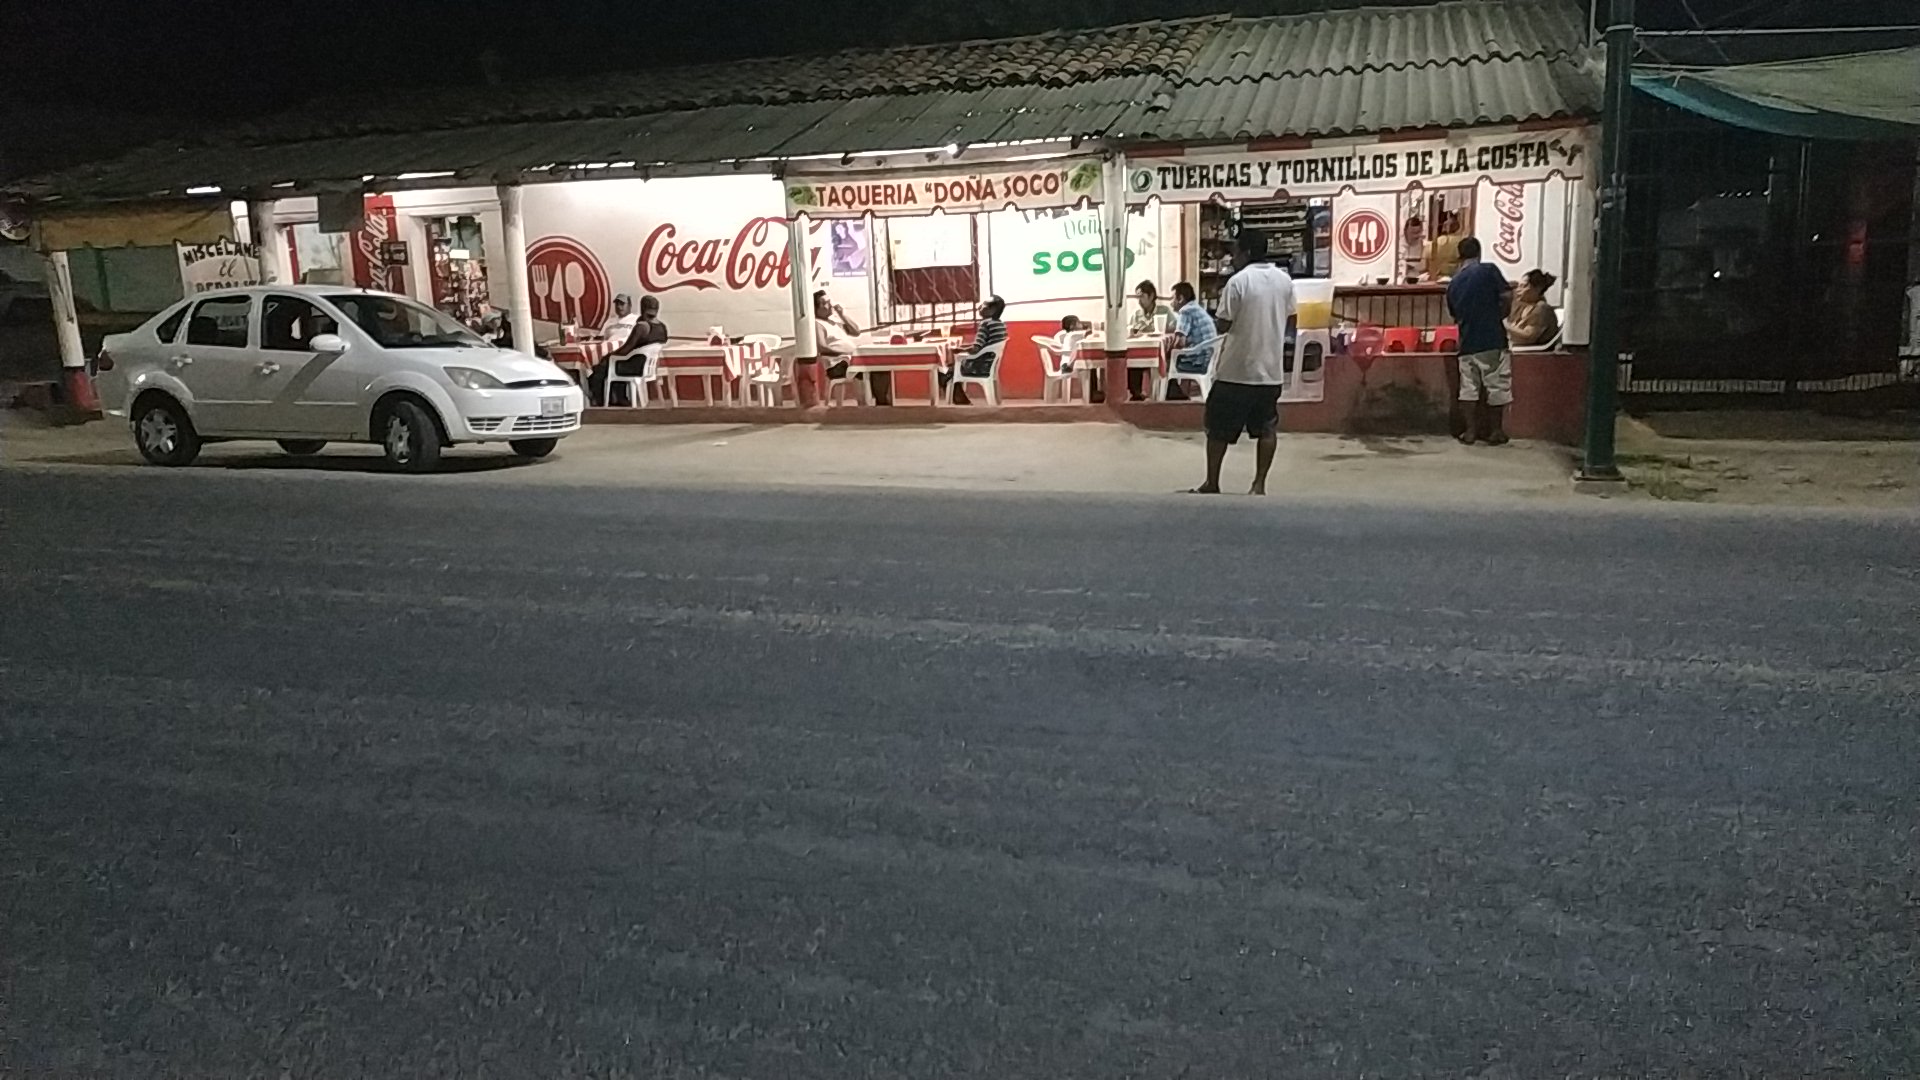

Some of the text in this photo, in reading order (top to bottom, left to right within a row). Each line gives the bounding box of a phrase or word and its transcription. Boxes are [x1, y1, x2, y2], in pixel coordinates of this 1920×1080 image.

[1157, 140, 1549, 190] TUERCAS Y TORNILLOS DE LA COSTA
[816, 184, 917, 208] TAQUERIA
[183, 242, 262, 267] MISCELANE
